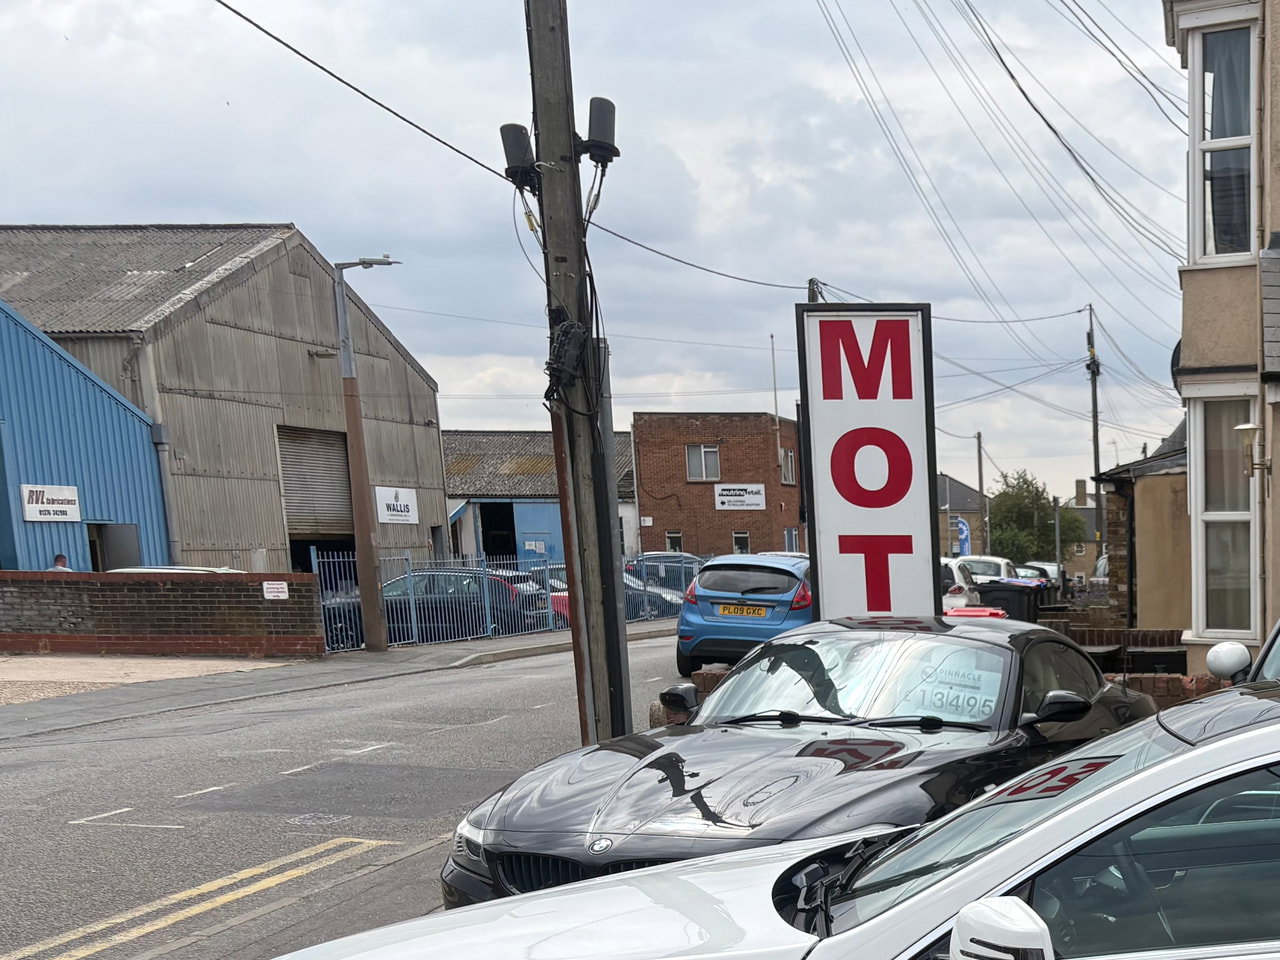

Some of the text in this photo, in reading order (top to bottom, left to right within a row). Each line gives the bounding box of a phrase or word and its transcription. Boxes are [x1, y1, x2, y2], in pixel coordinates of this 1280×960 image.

[818, 319, 914, 612] MOT
[27, 490, 45, 505] RVL
[385, 503, 410, 513] WALLIS
[722, 606, 762, 616] PL09 GXC
[939, 668, 982, 682] PINNACLE
